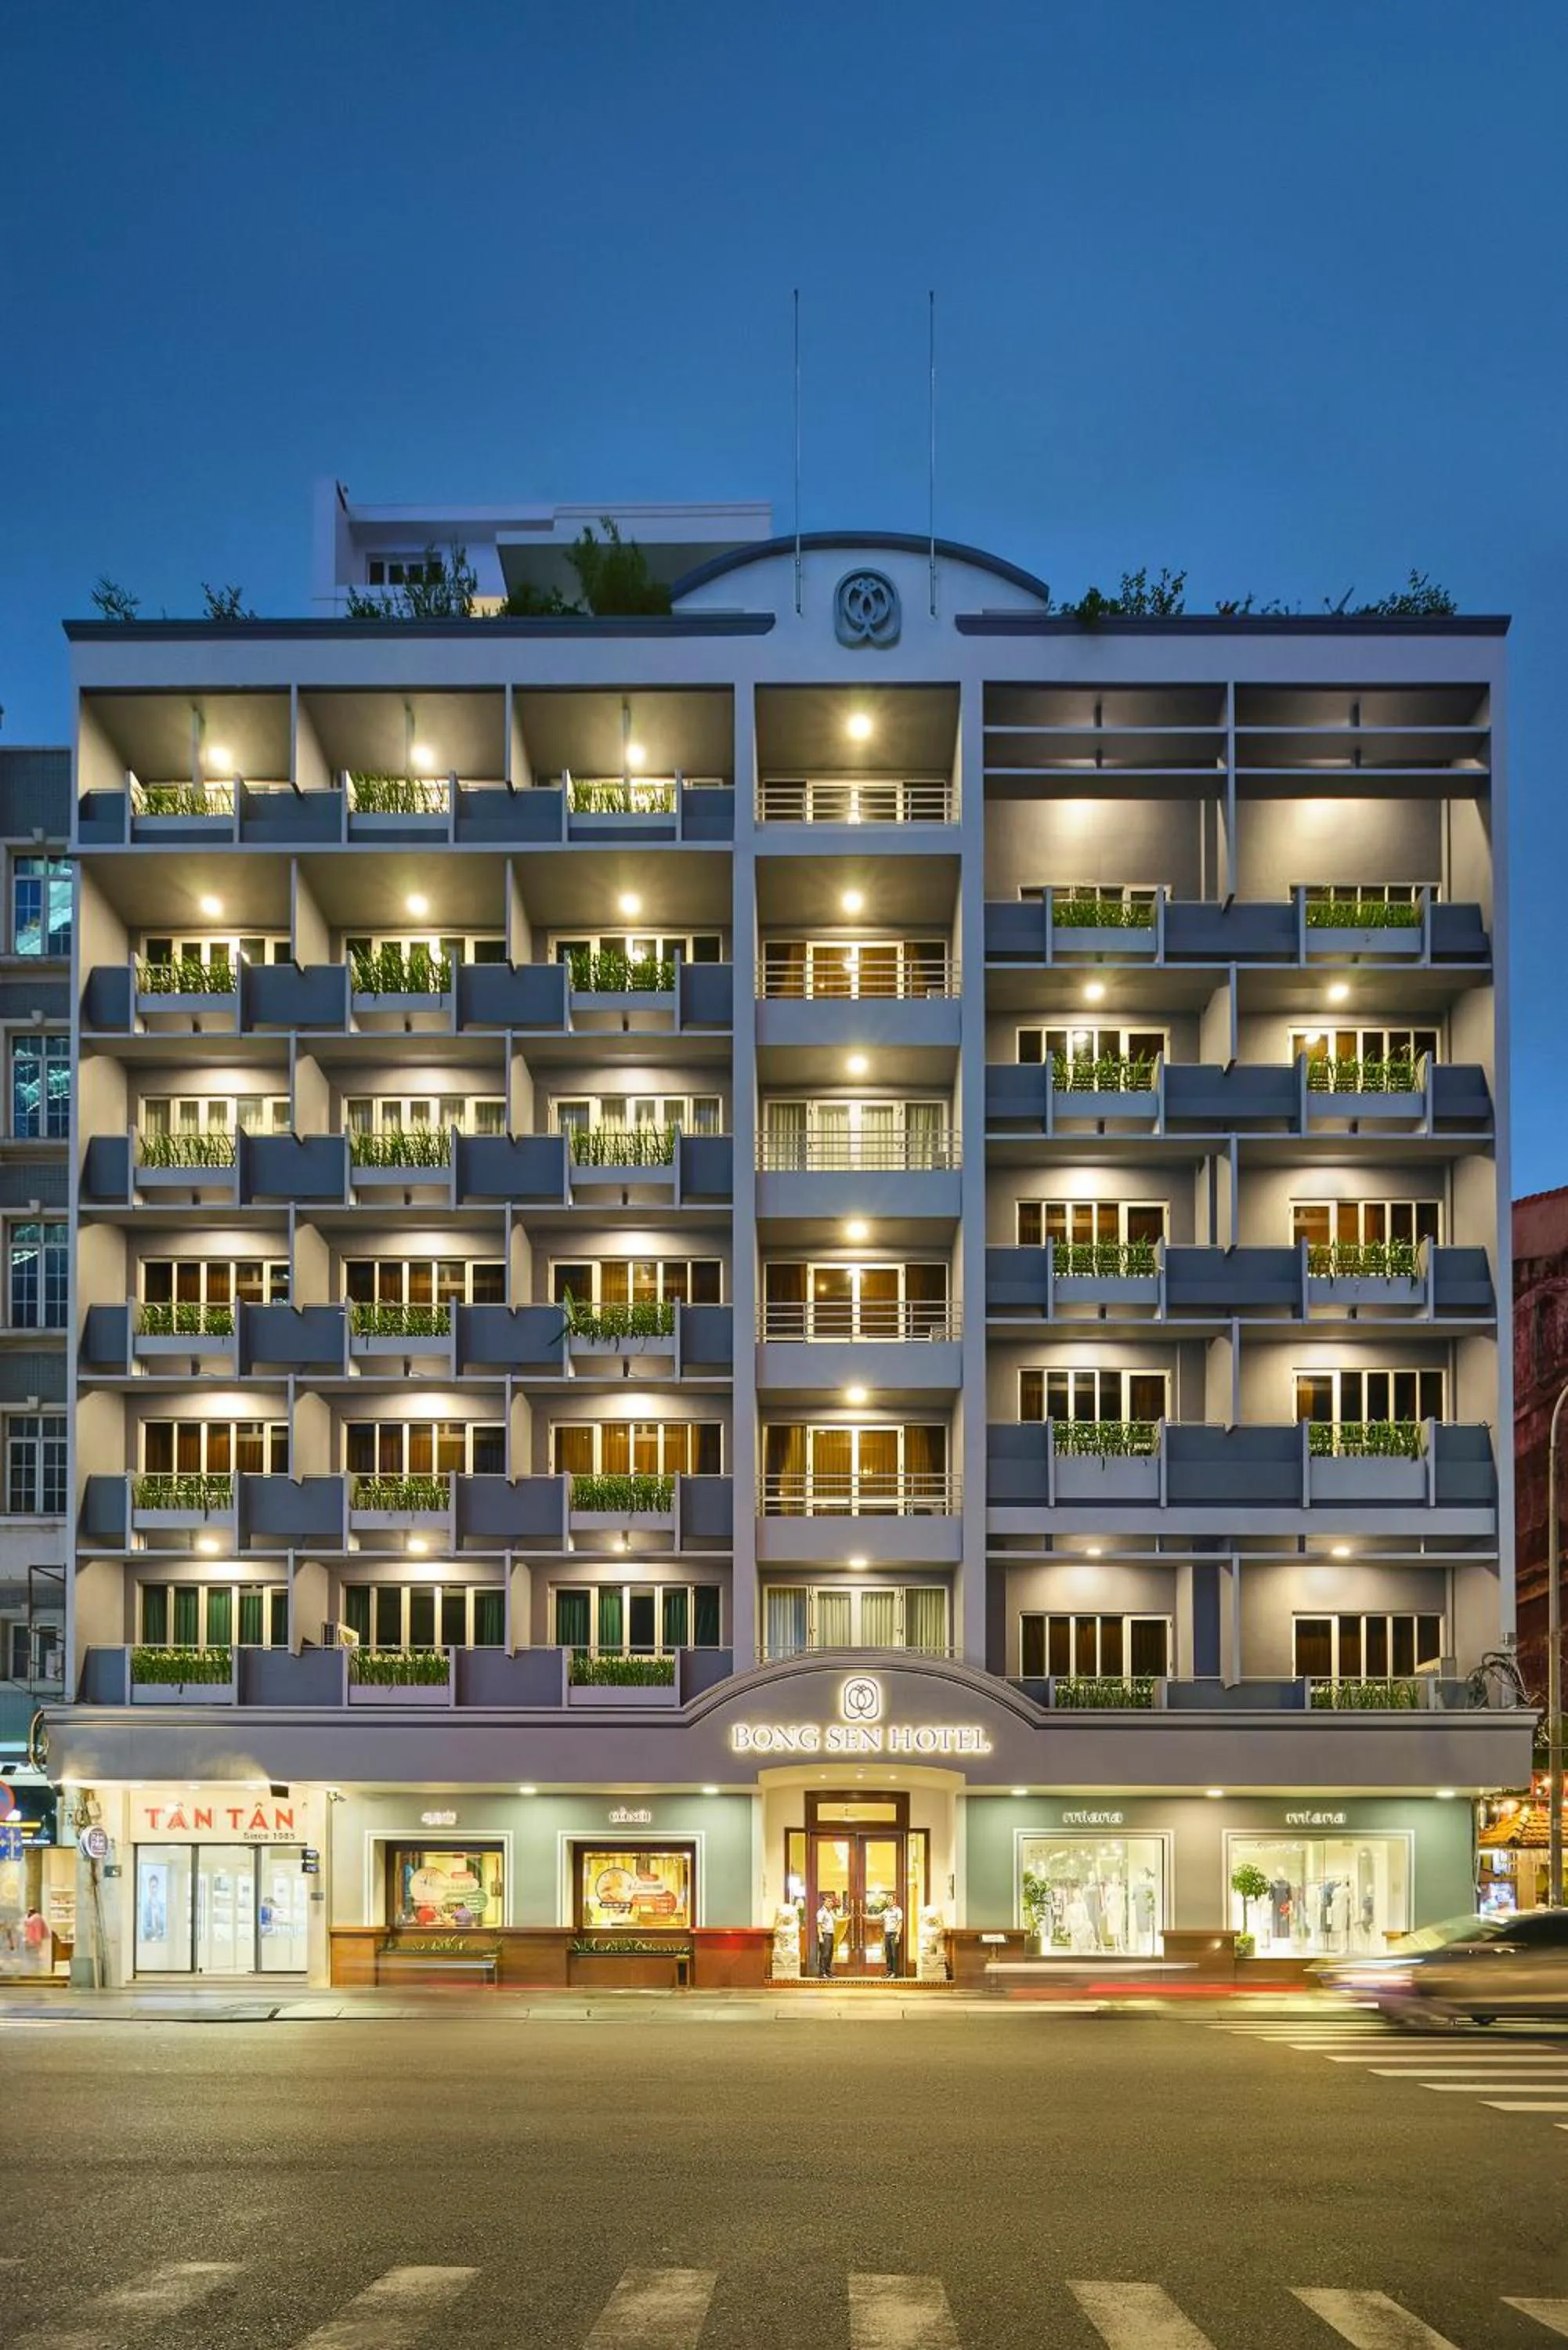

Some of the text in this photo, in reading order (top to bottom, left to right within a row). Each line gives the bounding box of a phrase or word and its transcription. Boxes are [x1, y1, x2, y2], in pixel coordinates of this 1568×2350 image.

[733, 1726, 991, 1751] BONG SEN HOTEL
